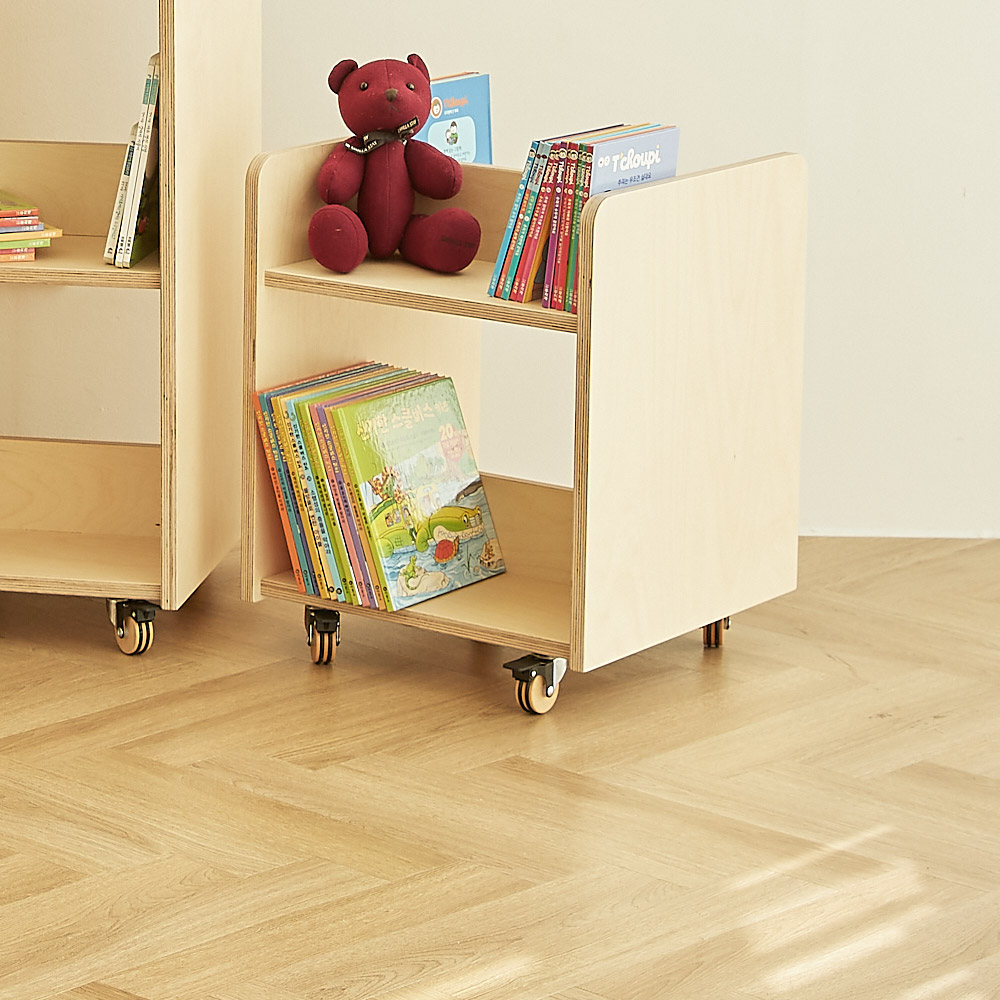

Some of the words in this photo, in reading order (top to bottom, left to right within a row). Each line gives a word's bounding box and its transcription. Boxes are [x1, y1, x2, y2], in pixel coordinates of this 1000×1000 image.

[612, 144, 661, 173] T'choupi
[356, 413, 390, 441] 신기한
[392, 402, 435, 429] 스쿨버스
[438, 423, 454, 441] 20
